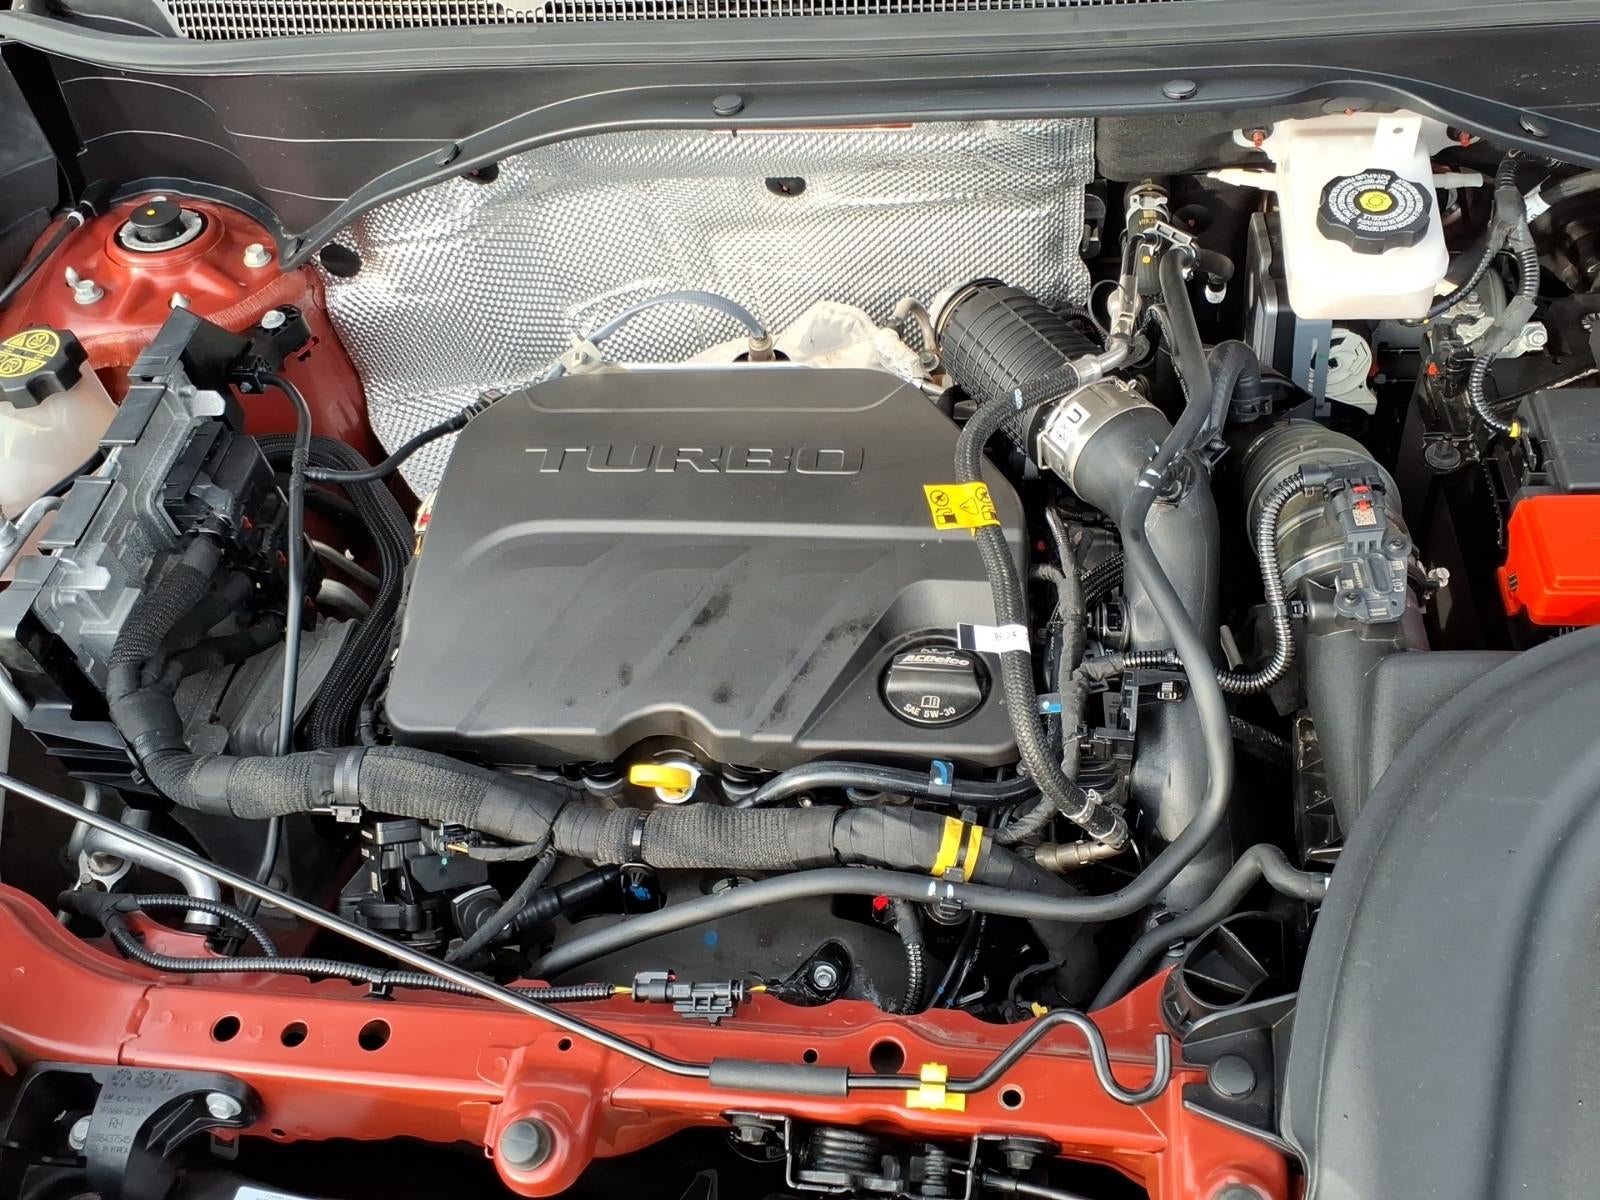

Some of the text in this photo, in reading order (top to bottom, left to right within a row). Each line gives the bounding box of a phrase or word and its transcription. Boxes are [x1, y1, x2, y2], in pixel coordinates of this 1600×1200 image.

[1067, 408, 1082, 424] U
[524, 446, 864, 475] TURBO
[901, 654, 970, 666] ACDelco
[903, 703, 956, 718] SAE 5W-30
